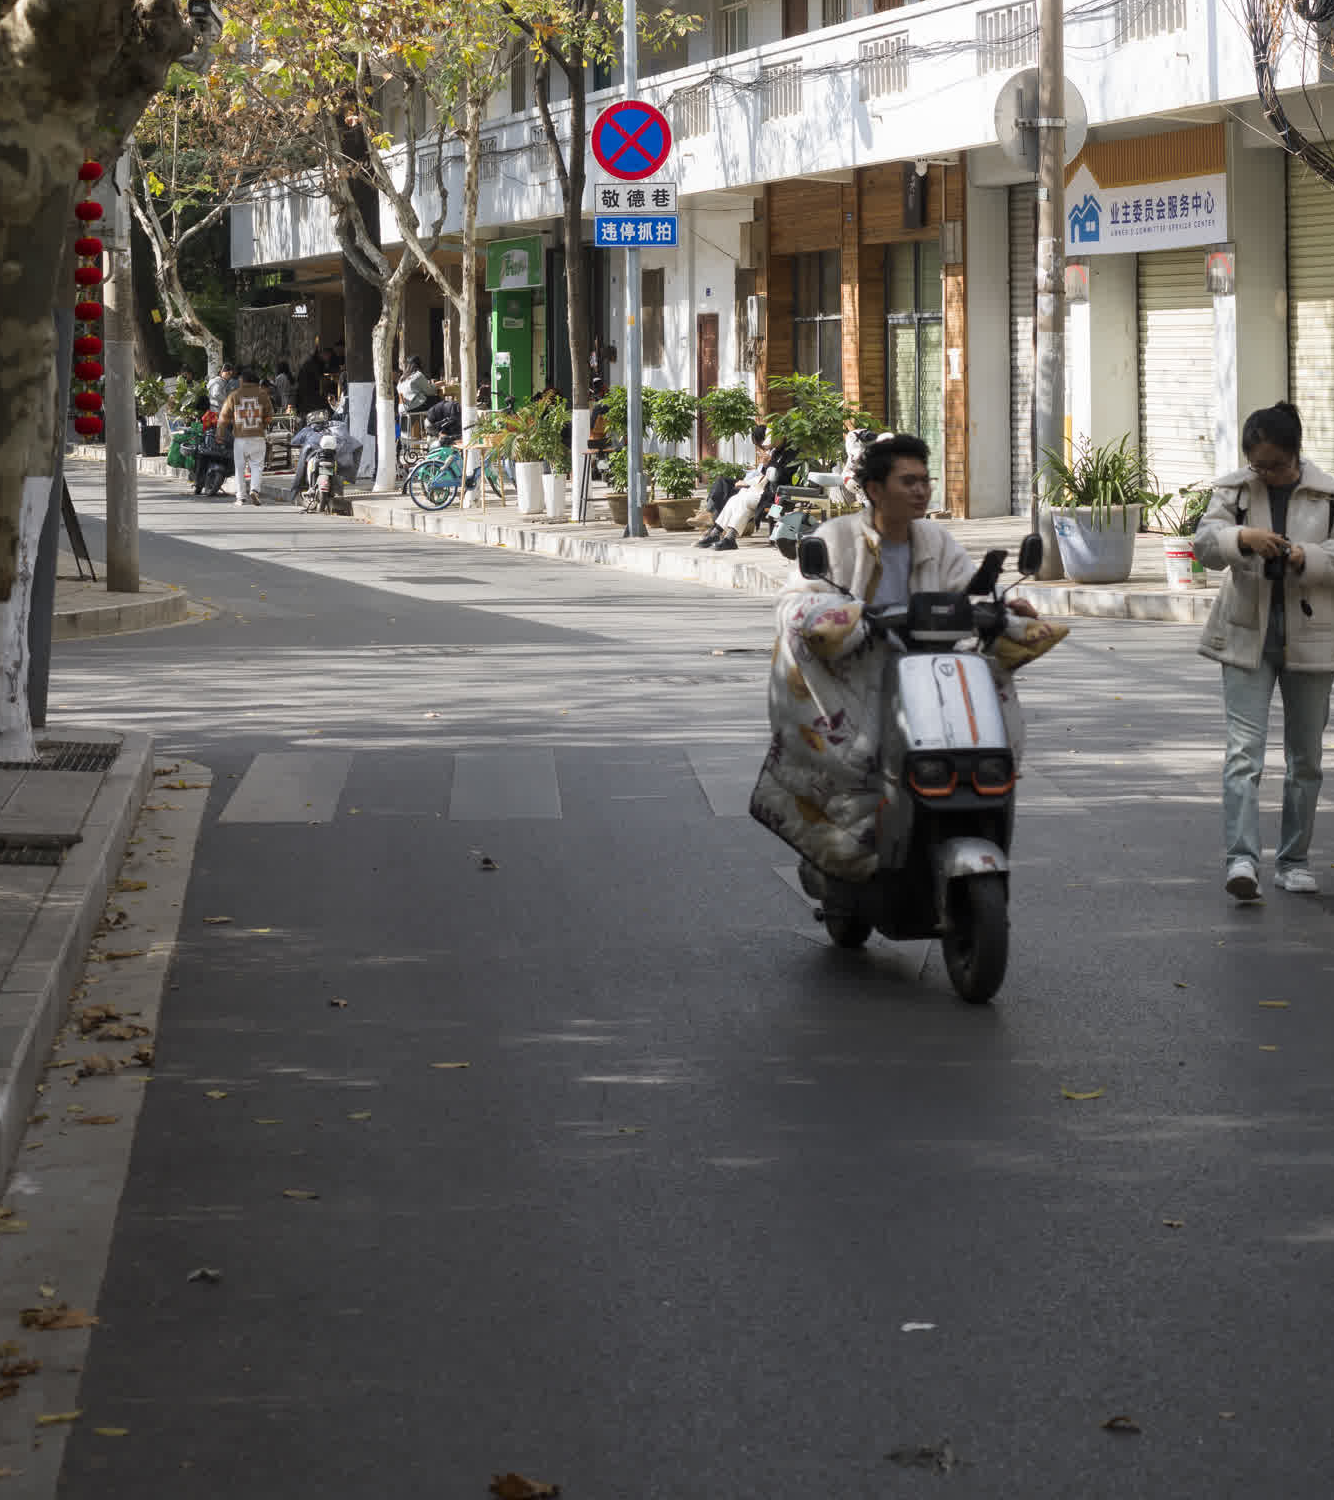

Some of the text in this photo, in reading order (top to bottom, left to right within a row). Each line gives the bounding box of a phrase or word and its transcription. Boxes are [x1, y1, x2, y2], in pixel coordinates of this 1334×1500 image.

[601, 188, 671, 209] 敬德巷
[1110, 190, 1216, 225] 业主委员会服务中心
[601, 221, 672, 242] 违停抓拍
[1193, 219, 1216, 228] CENTER
